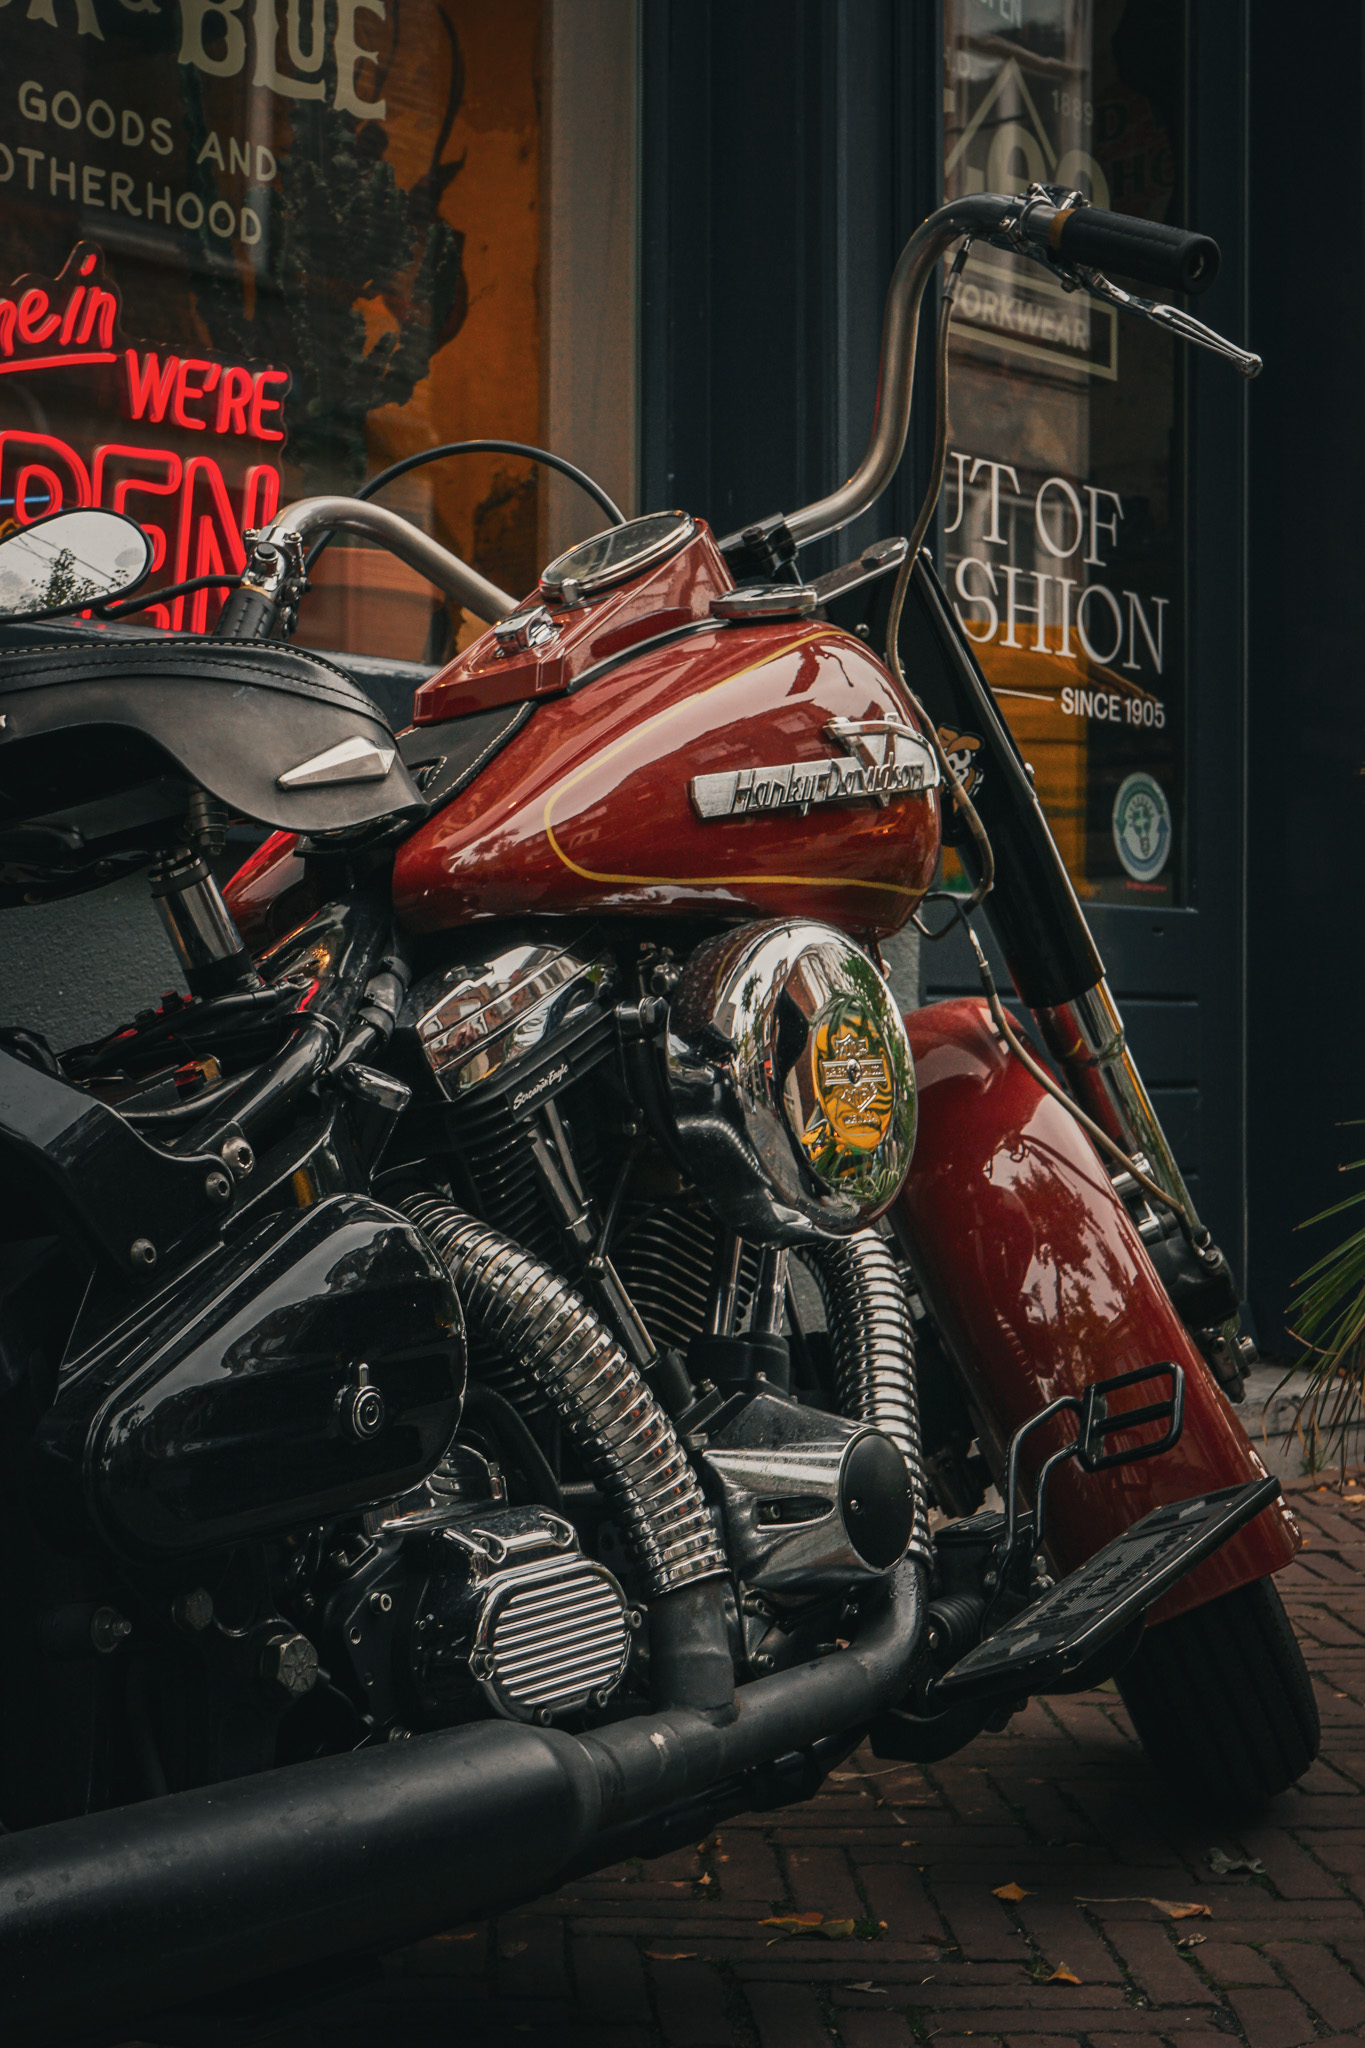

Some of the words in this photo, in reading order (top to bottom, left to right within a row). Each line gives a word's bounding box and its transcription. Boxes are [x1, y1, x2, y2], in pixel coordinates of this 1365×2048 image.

[18, 80, 174, 155] GOODS
[197, 131, 277, 182] AND
[1051, 89, 1093, 126] 1889
[125, 349, 288, 441] WE'RE
[1035, 477, 1125, 567] OF
[1061, 686, 1122, 722] SINCE
[1124, 697, 1166, 729] 1905
